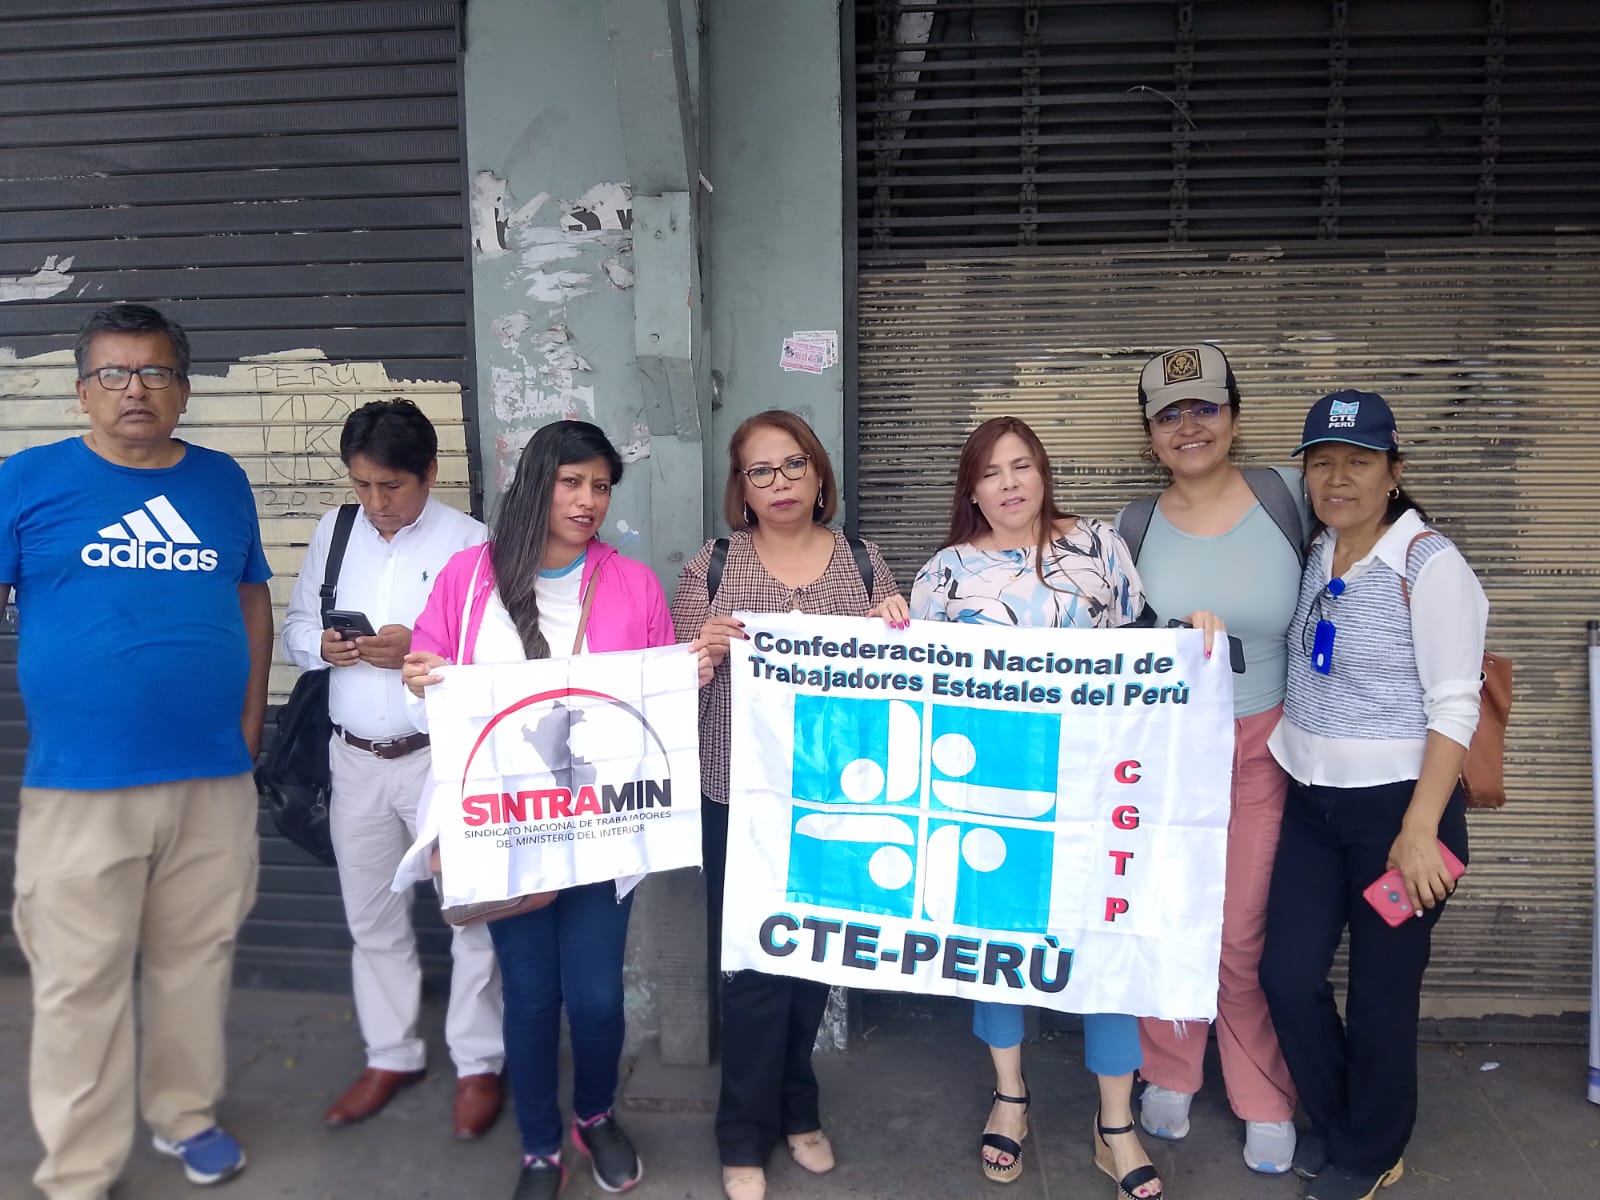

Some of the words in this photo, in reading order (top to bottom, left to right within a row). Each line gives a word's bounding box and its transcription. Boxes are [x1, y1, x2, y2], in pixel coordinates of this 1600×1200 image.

[81, 538, 218, 571] adidas
[753, 631, 973, 668] Confederaciòn
[983, 649, 1124, 676] Nacional
[1133, 653, 1174, 674] de
[748, 656, 924, 692] Trabajadores
[932, 674, 1061, 704] Estatales
[1070, 682, 1115, 706] del
[1123, 684, 1190, 707] Perù
[462, 779, 672, 826] SINTRAMIN
[464, 827, 521, 839] SINDICATO
[524, 821, 577, 834] NACIONAL
[579, 819, 593, 828] DE
[516, 832, 575, 846] MINISTERIO
[577, 831, 597, 841] DEL
[600, 824, 646, 838] INTERIOR
